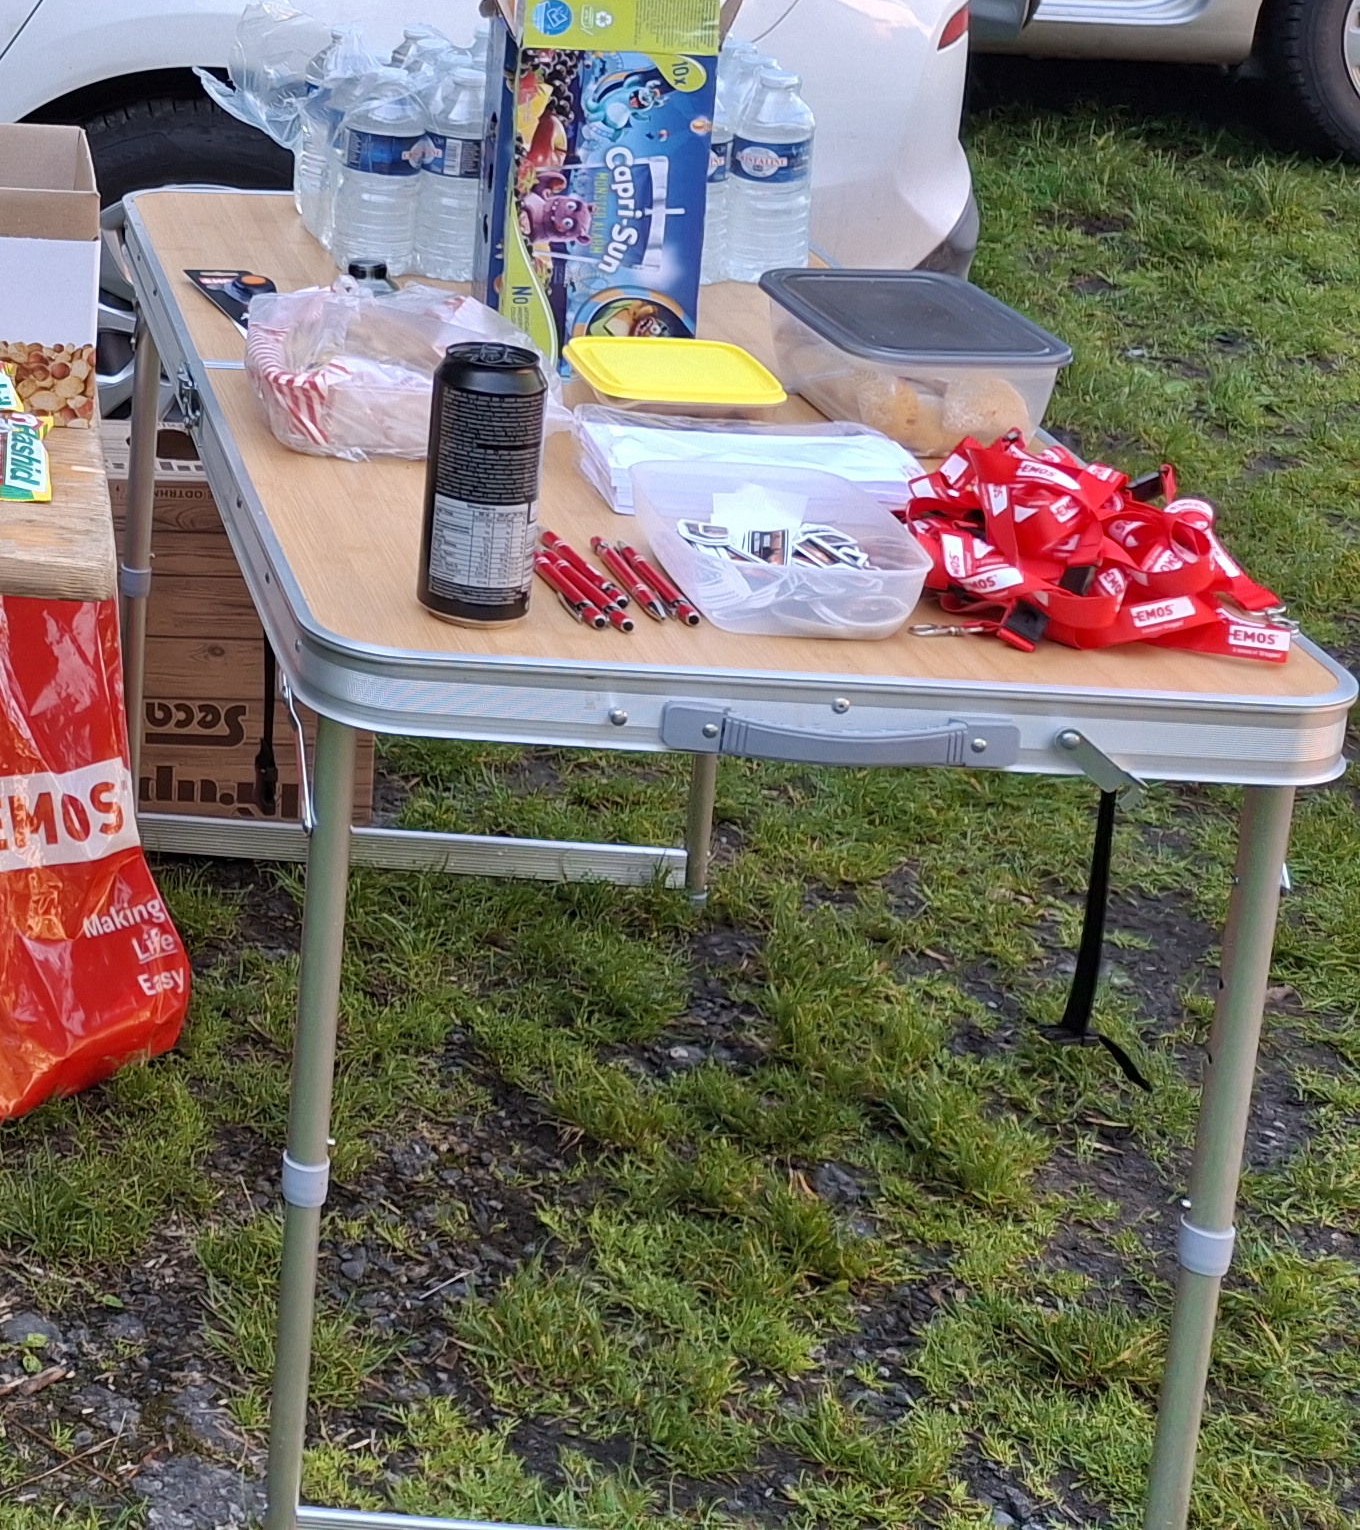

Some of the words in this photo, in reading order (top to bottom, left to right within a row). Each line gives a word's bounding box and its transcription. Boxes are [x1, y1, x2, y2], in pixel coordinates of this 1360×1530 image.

[671, 61, 690, 86] 10x
[593, 172, 609, 223] MONSTER
[598, 146, 644, 274] Capri-Sun
[589, 223, 608, 255] ALARM
[1021, 463, 1055, 477] EMOS
[1136, 605, 1174, 622] EMOS
[1233, 629, 1276, 646] EMOS
[82, 898, 167, 939] Making
[131, 928, 176, 961] Life
[137, 967, 185, 996] Easy
